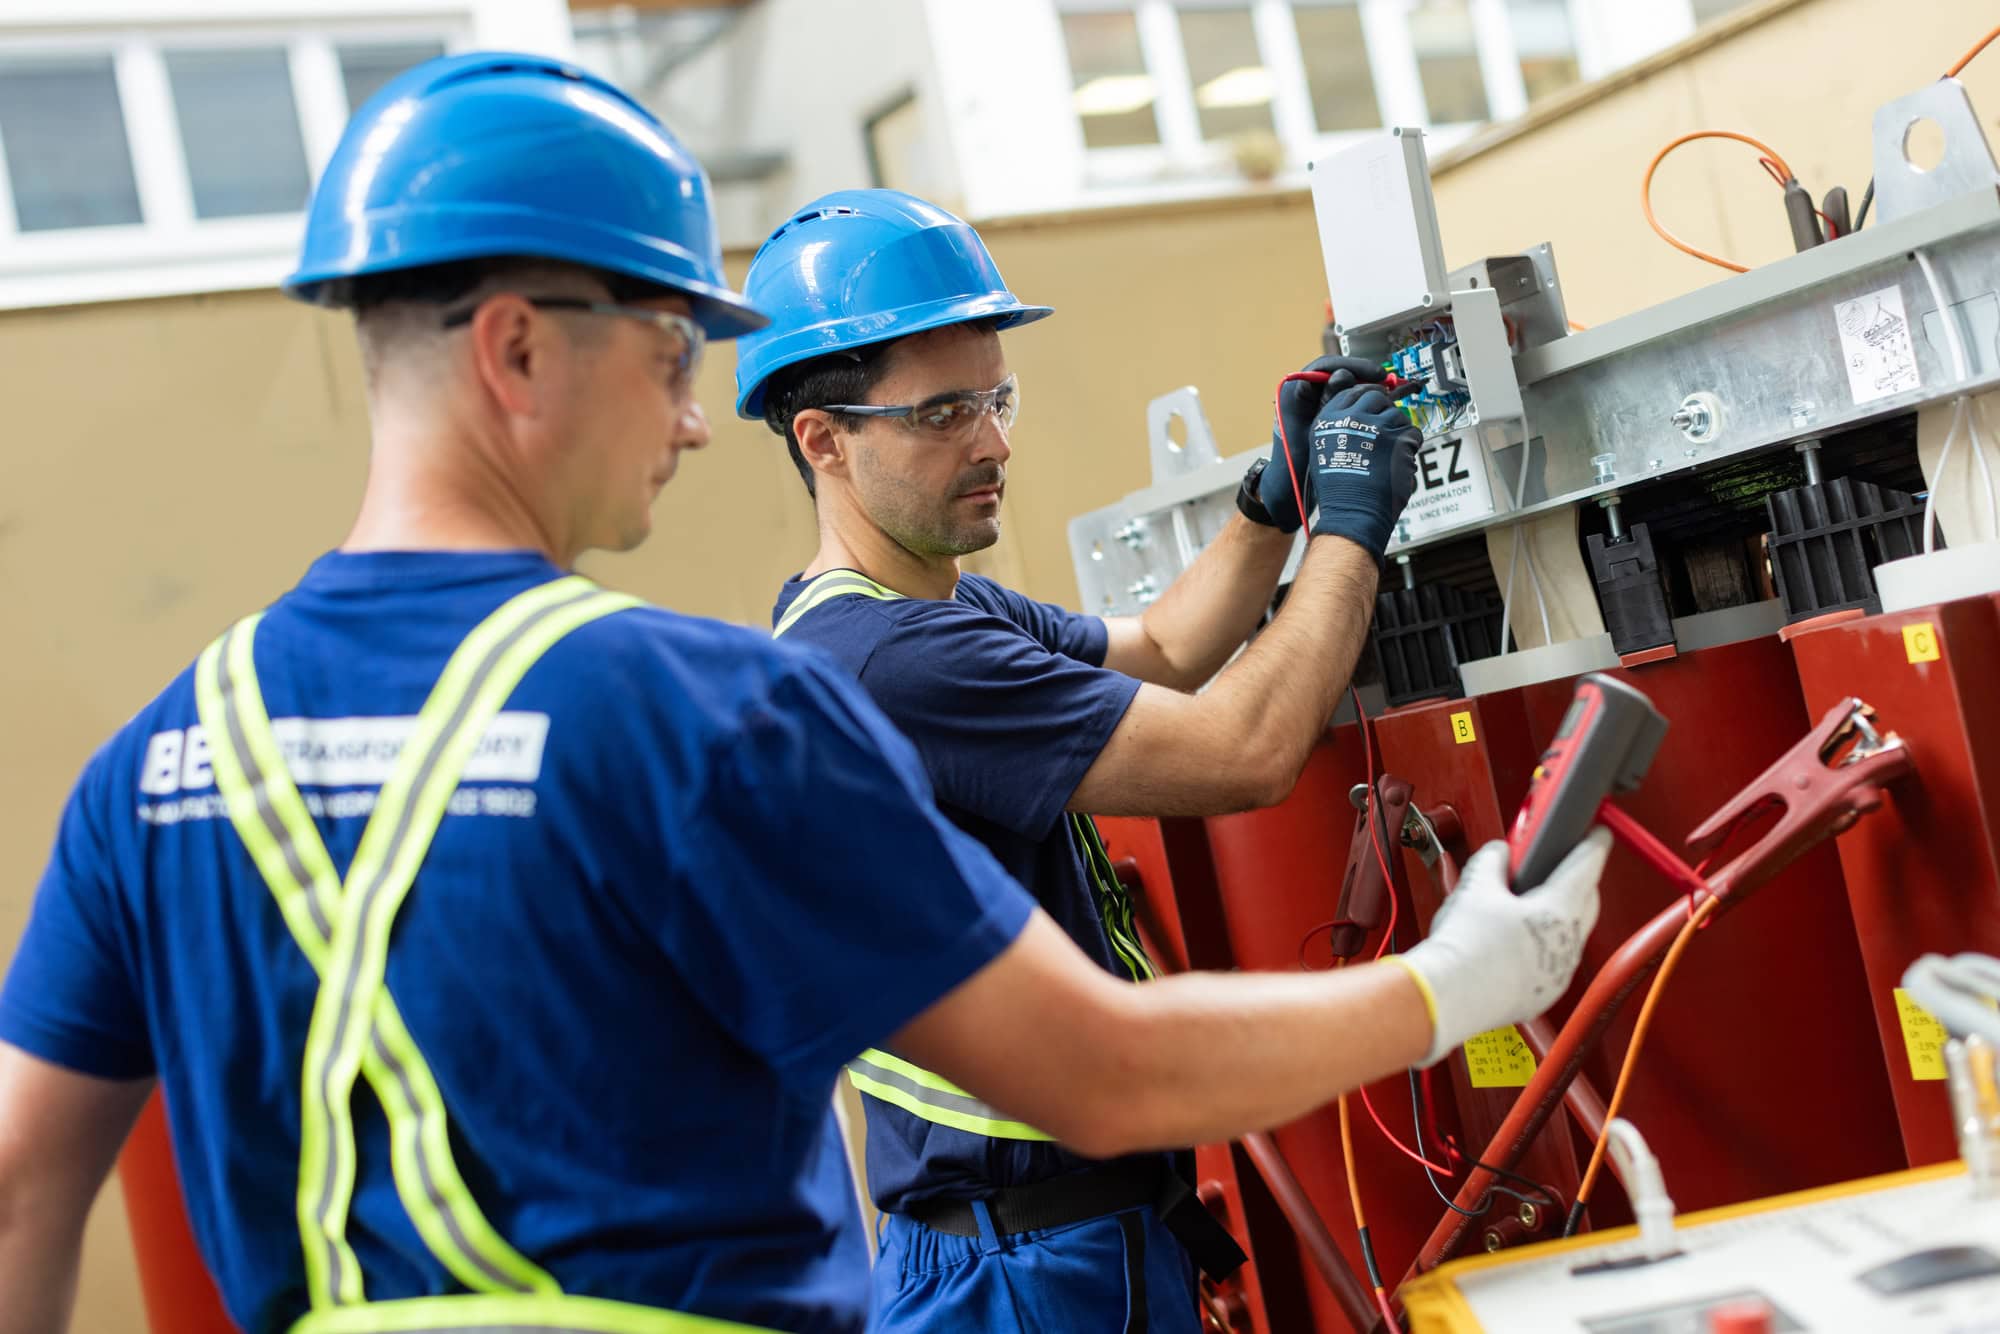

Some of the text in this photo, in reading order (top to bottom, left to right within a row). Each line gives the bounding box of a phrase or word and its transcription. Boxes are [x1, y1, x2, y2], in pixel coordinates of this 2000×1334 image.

[1412, 438, 1470, 494] EZ
[1913, 632, 1929, 653] C
[1458, 719, 1468, 737] B
[139, 724, 214, 795] BE
